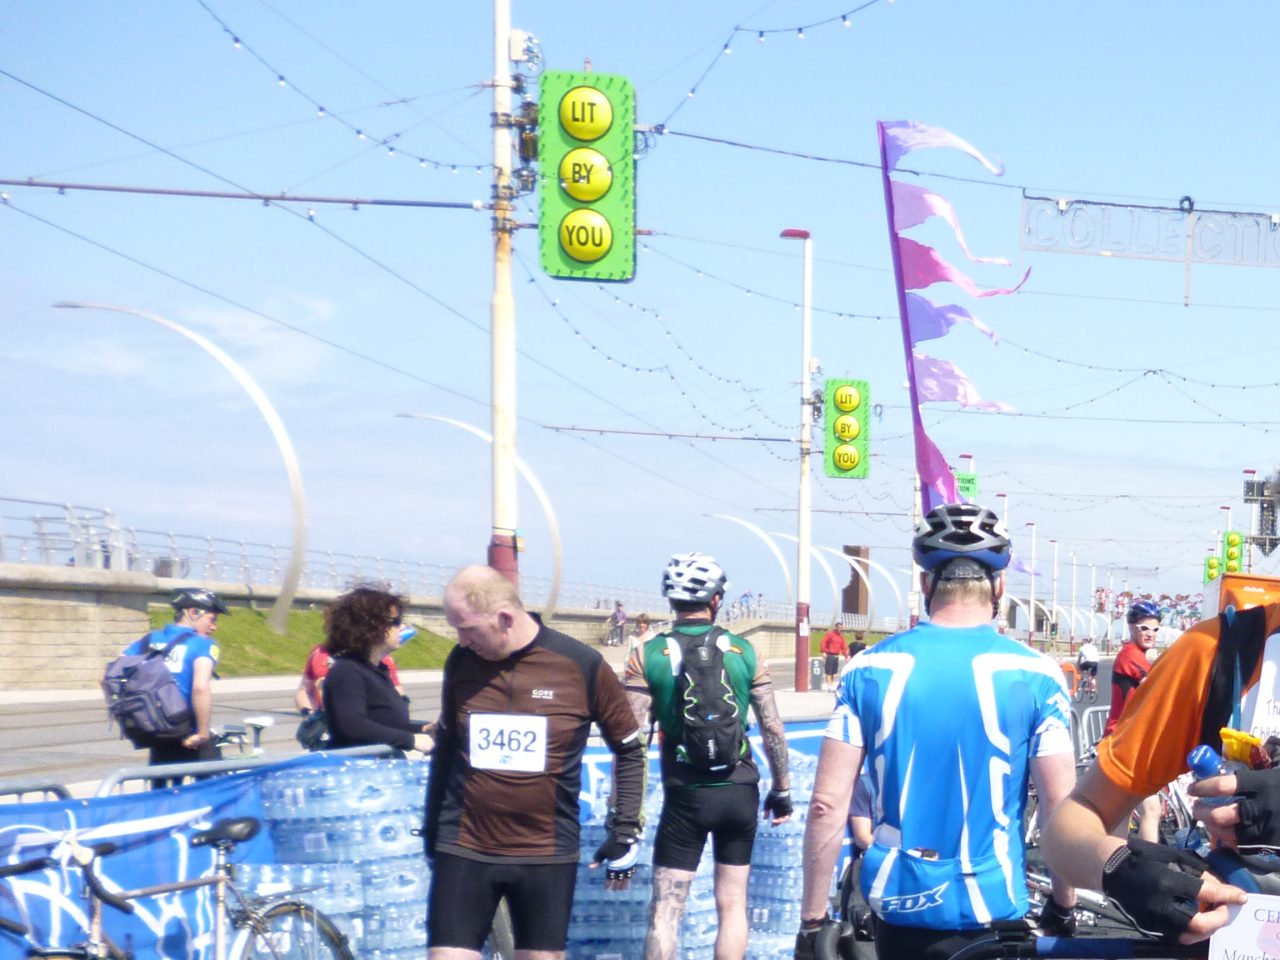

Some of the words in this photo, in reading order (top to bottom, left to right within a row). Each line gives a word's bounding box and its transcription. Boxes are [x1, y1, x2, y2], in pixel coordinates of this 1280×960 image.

[571, 101, 596, 123] LIT
[572, 162, 594, 184] BY
[565, 225, 603, 247] YOU
[840, 394, 853, 405] LIT
[840, 423, 851, 433] BY
[837, 452, 856, 464] YOU
[477, 728, 537, 753] 3462
[880, 881, 949, 913] FOX
